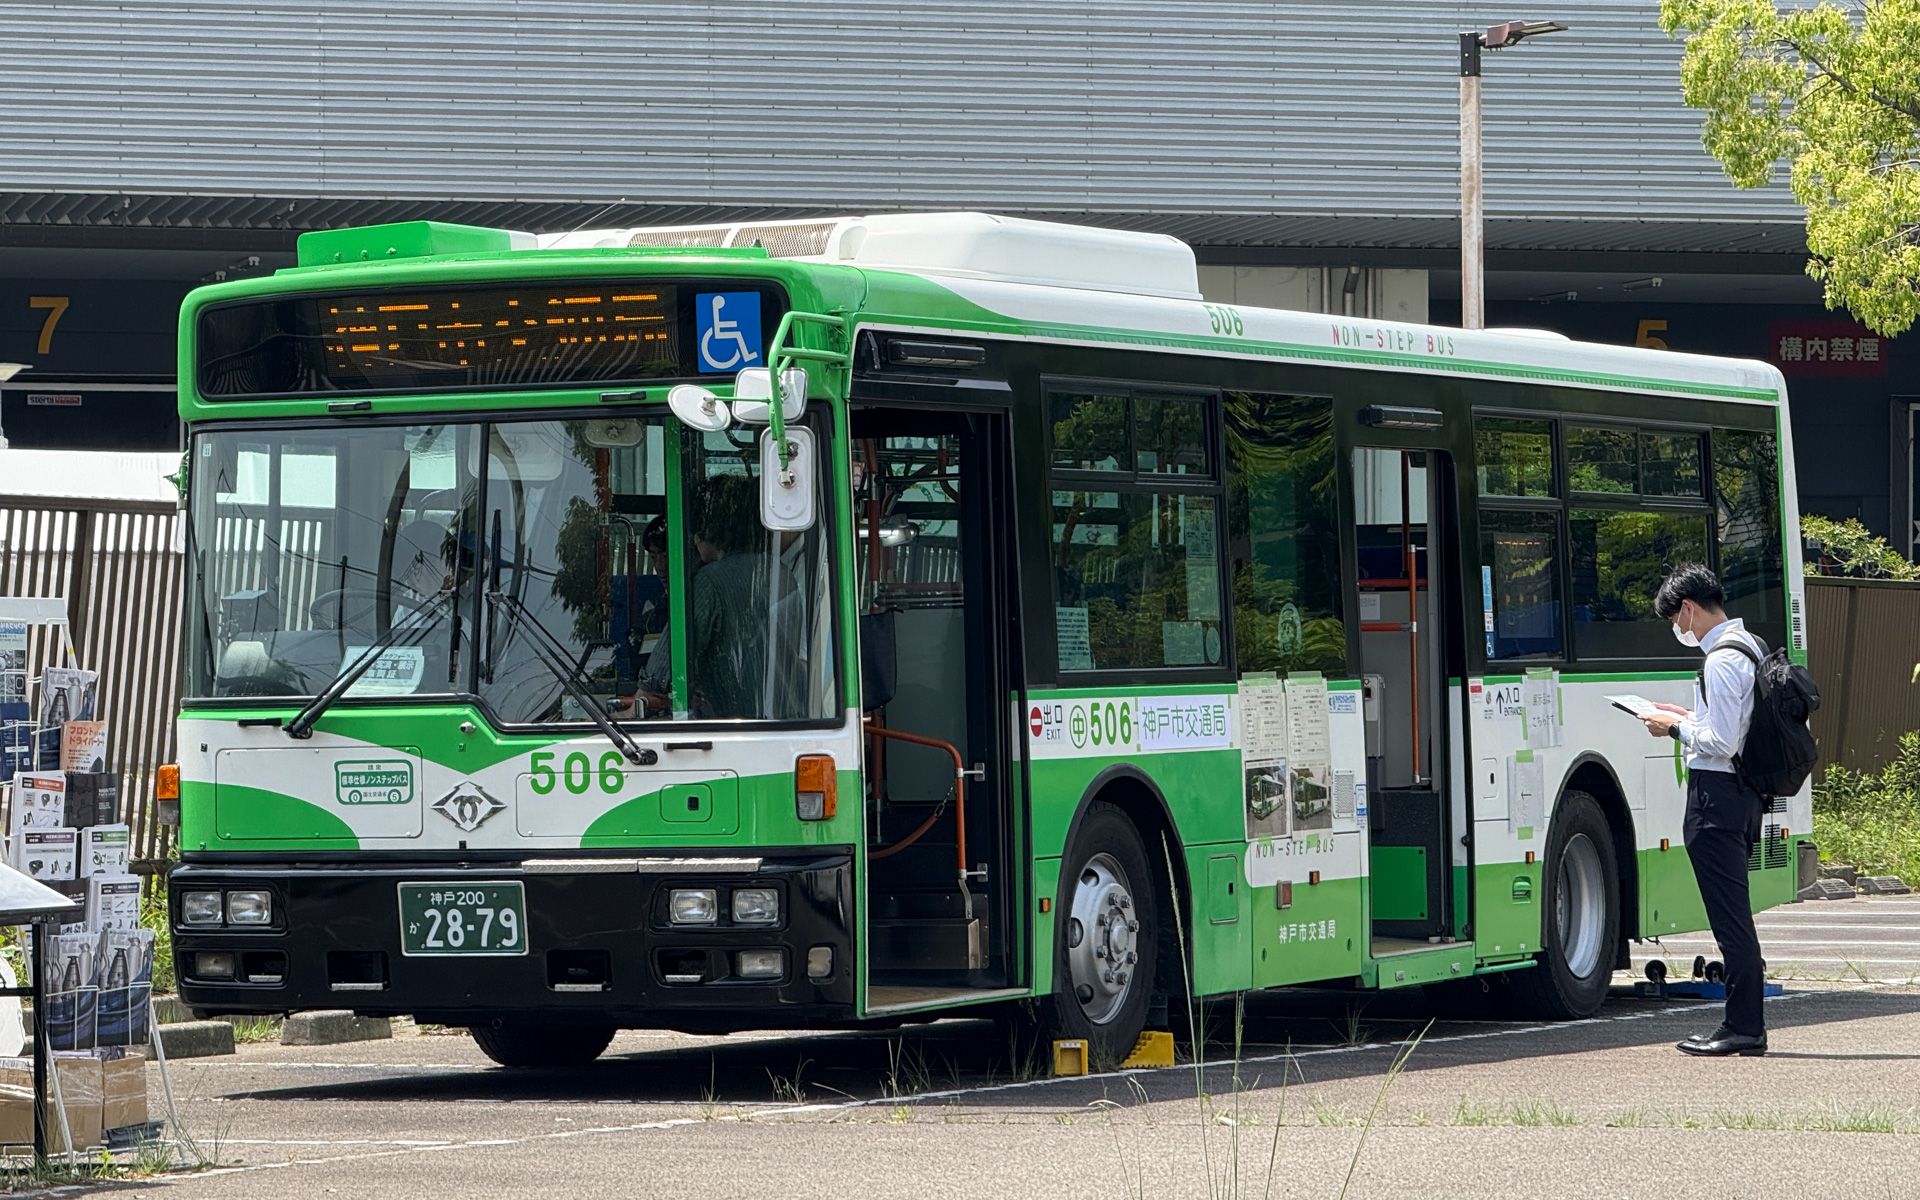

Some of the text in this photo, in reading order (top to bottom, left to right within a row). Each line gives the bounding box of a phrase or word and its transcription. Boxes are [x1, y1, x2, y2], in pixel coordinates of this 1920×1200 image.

[29, 296, 69, 354] 7
[1202, 304, 1244, 337] 506
[1331, 323, 1454, 356] NON-STEP BUS
[1779, 336, 1880, 362] 構内禁煙
[1505, 687, 1520, 704] 入口
[1043, 703, 1063, 725] 出口
[1142, 704, 1227, 740] 神戸市交通局
[1046, 728, 1061, 740] EXIT
[530, 751, 625, 795] 506
[1256, 838, 1335, 859] NON-STEP BUS
[409, 907, 518, 948] か 28-79
[1279, 919, 1336, 945] 神戸市交通局
